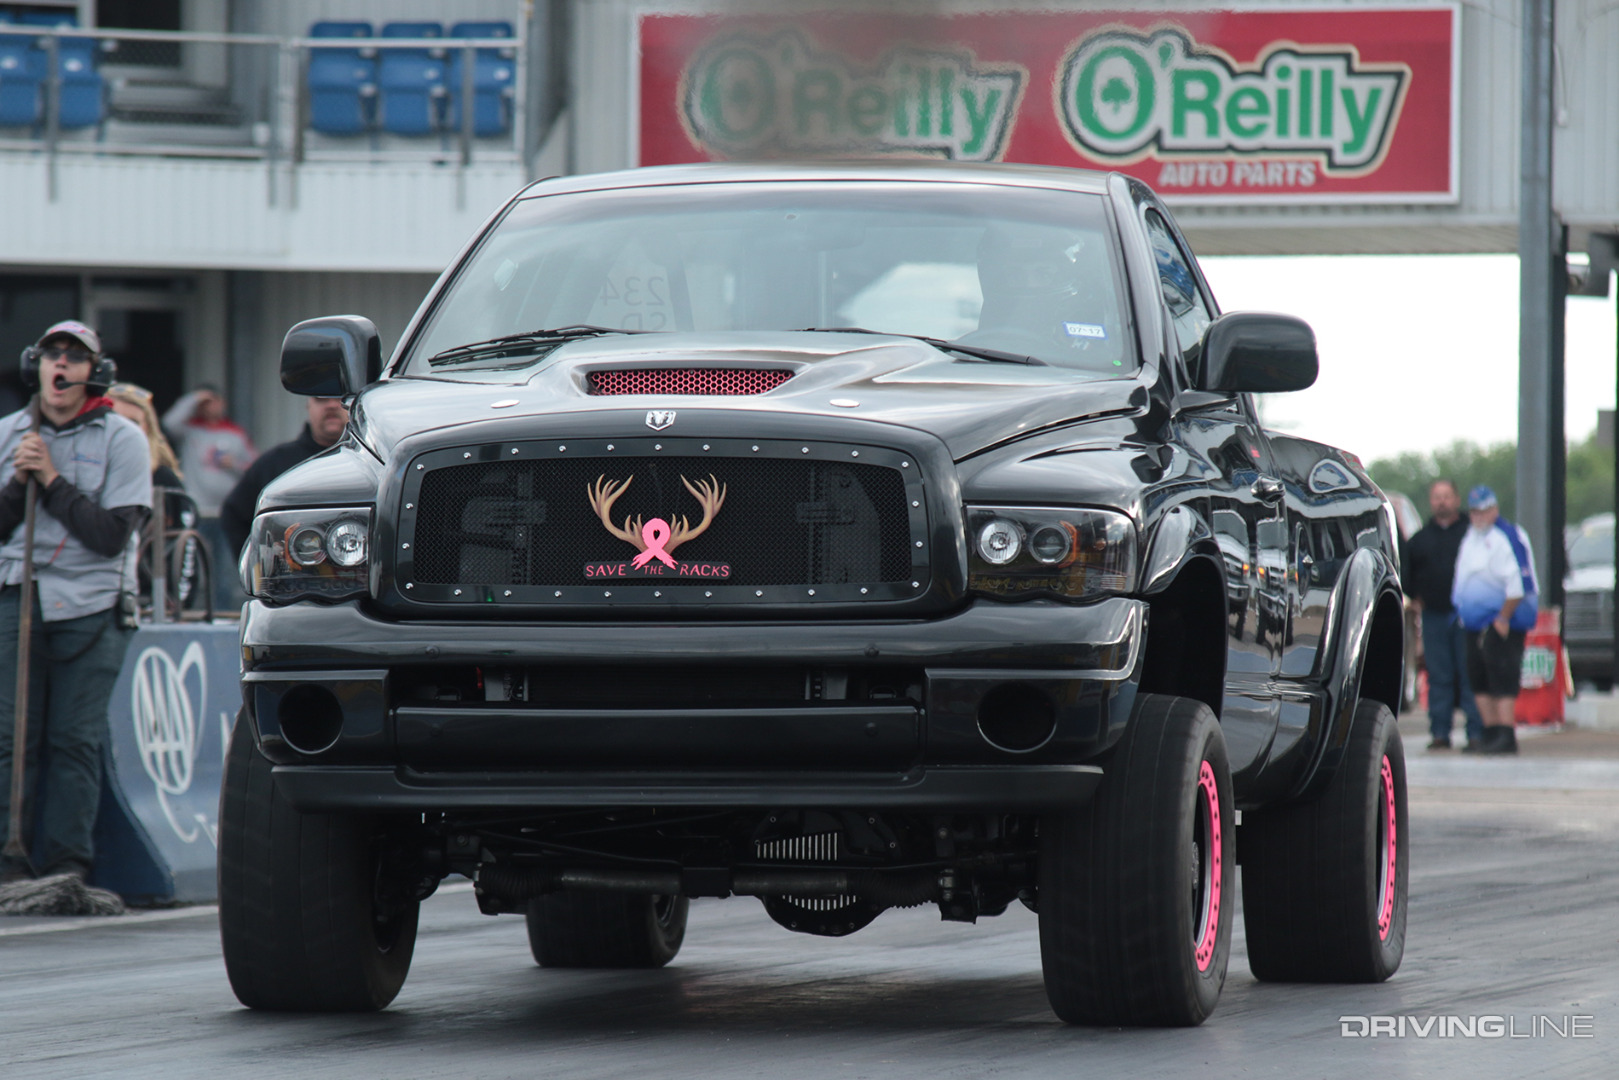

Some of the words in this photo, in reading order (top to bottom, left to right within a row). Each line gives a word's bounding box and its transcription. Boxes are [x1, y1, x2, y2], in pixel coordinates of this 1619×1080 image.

[700, 43, 1001, 154] O'Reilly
[1075, 42, 1383, 155] O'Reilly
[1157, 162, 1228, 187] AUTO
[1232, 162, 1317, 187] PARTS
[585, 564, 627, 577] SAVE
[643, 565, 664, 575] THE
[679, 564, 730, 577] RACKS
